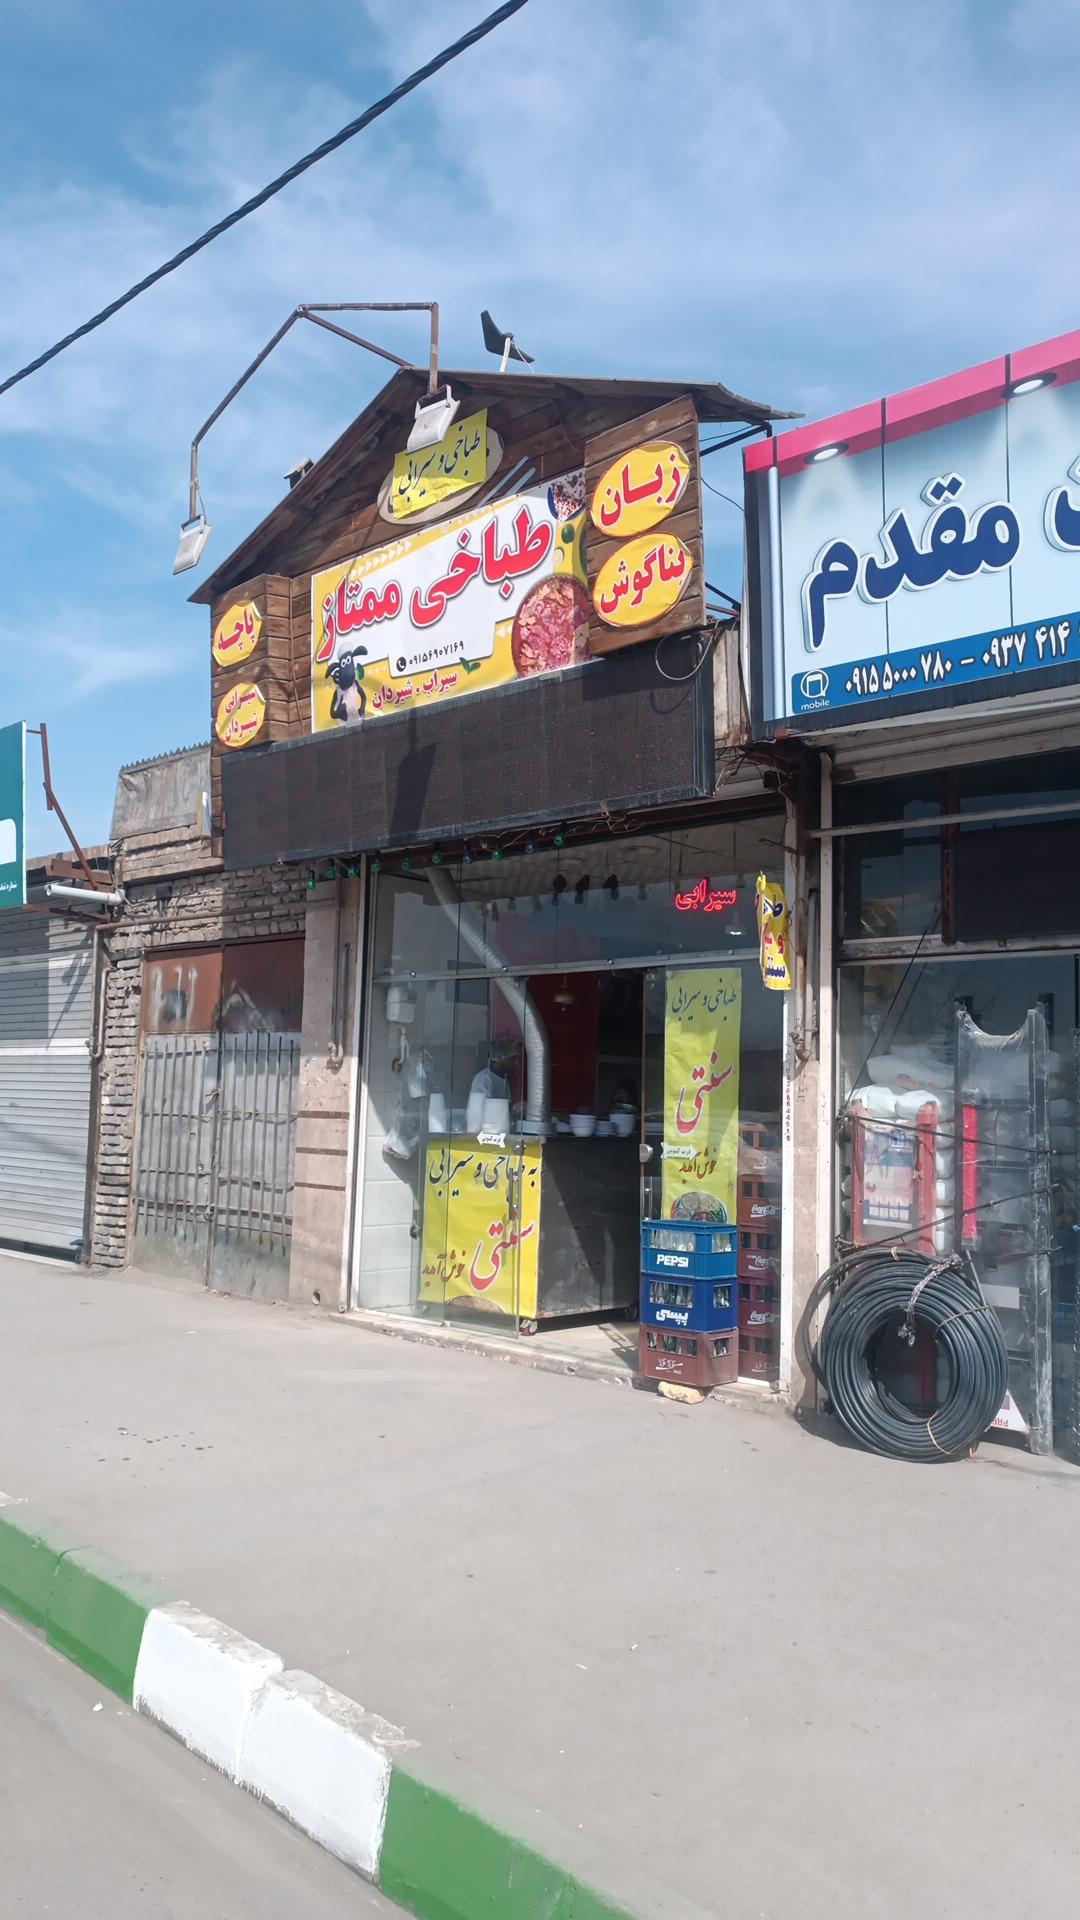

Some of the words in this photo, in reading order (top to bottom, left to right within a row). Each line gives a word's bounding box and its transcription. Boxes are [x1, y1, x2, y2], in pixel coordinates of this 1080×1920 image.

[437, 454, 444, 471] و
[444, 425, 480, 476] طباخی
[399, 451, 436, 502] سیرابی
[600, 453, 680, 526] زبان
[411, 506, 552, 627] طباخی
[600, 544, 685, 613] بناگوش
[802, 473, 1022, 652] مقدم
[218, 608, 255, 650] پاچه
[316, 576, 401, 662] ممتاز
[423, 669, 457, 695] سیراب
[845, 664, 879, 696] ۰۹۱۵
[920, 650, 952, 682] ۷۸۰
[982, 632, 1027, 668] ۰۹۳۷
[1034, 621, 1071, 659] ۴۱۴
[372, 679, 413, 710] شیردان
[800, 699, 830, 711] mobile
[675, 879, 737, 912] سیرابی
[671, 986, 701, 1021] سیرابی
[707, 977, 737, 1021] طباخی
[675, 1051, 733, 1134] سنتی
[429, 1147, 474, 1197] سیرابی
[656, 1253, 689, 1268] PEPSI
[655, 1309, 689, 1326] پپسی
